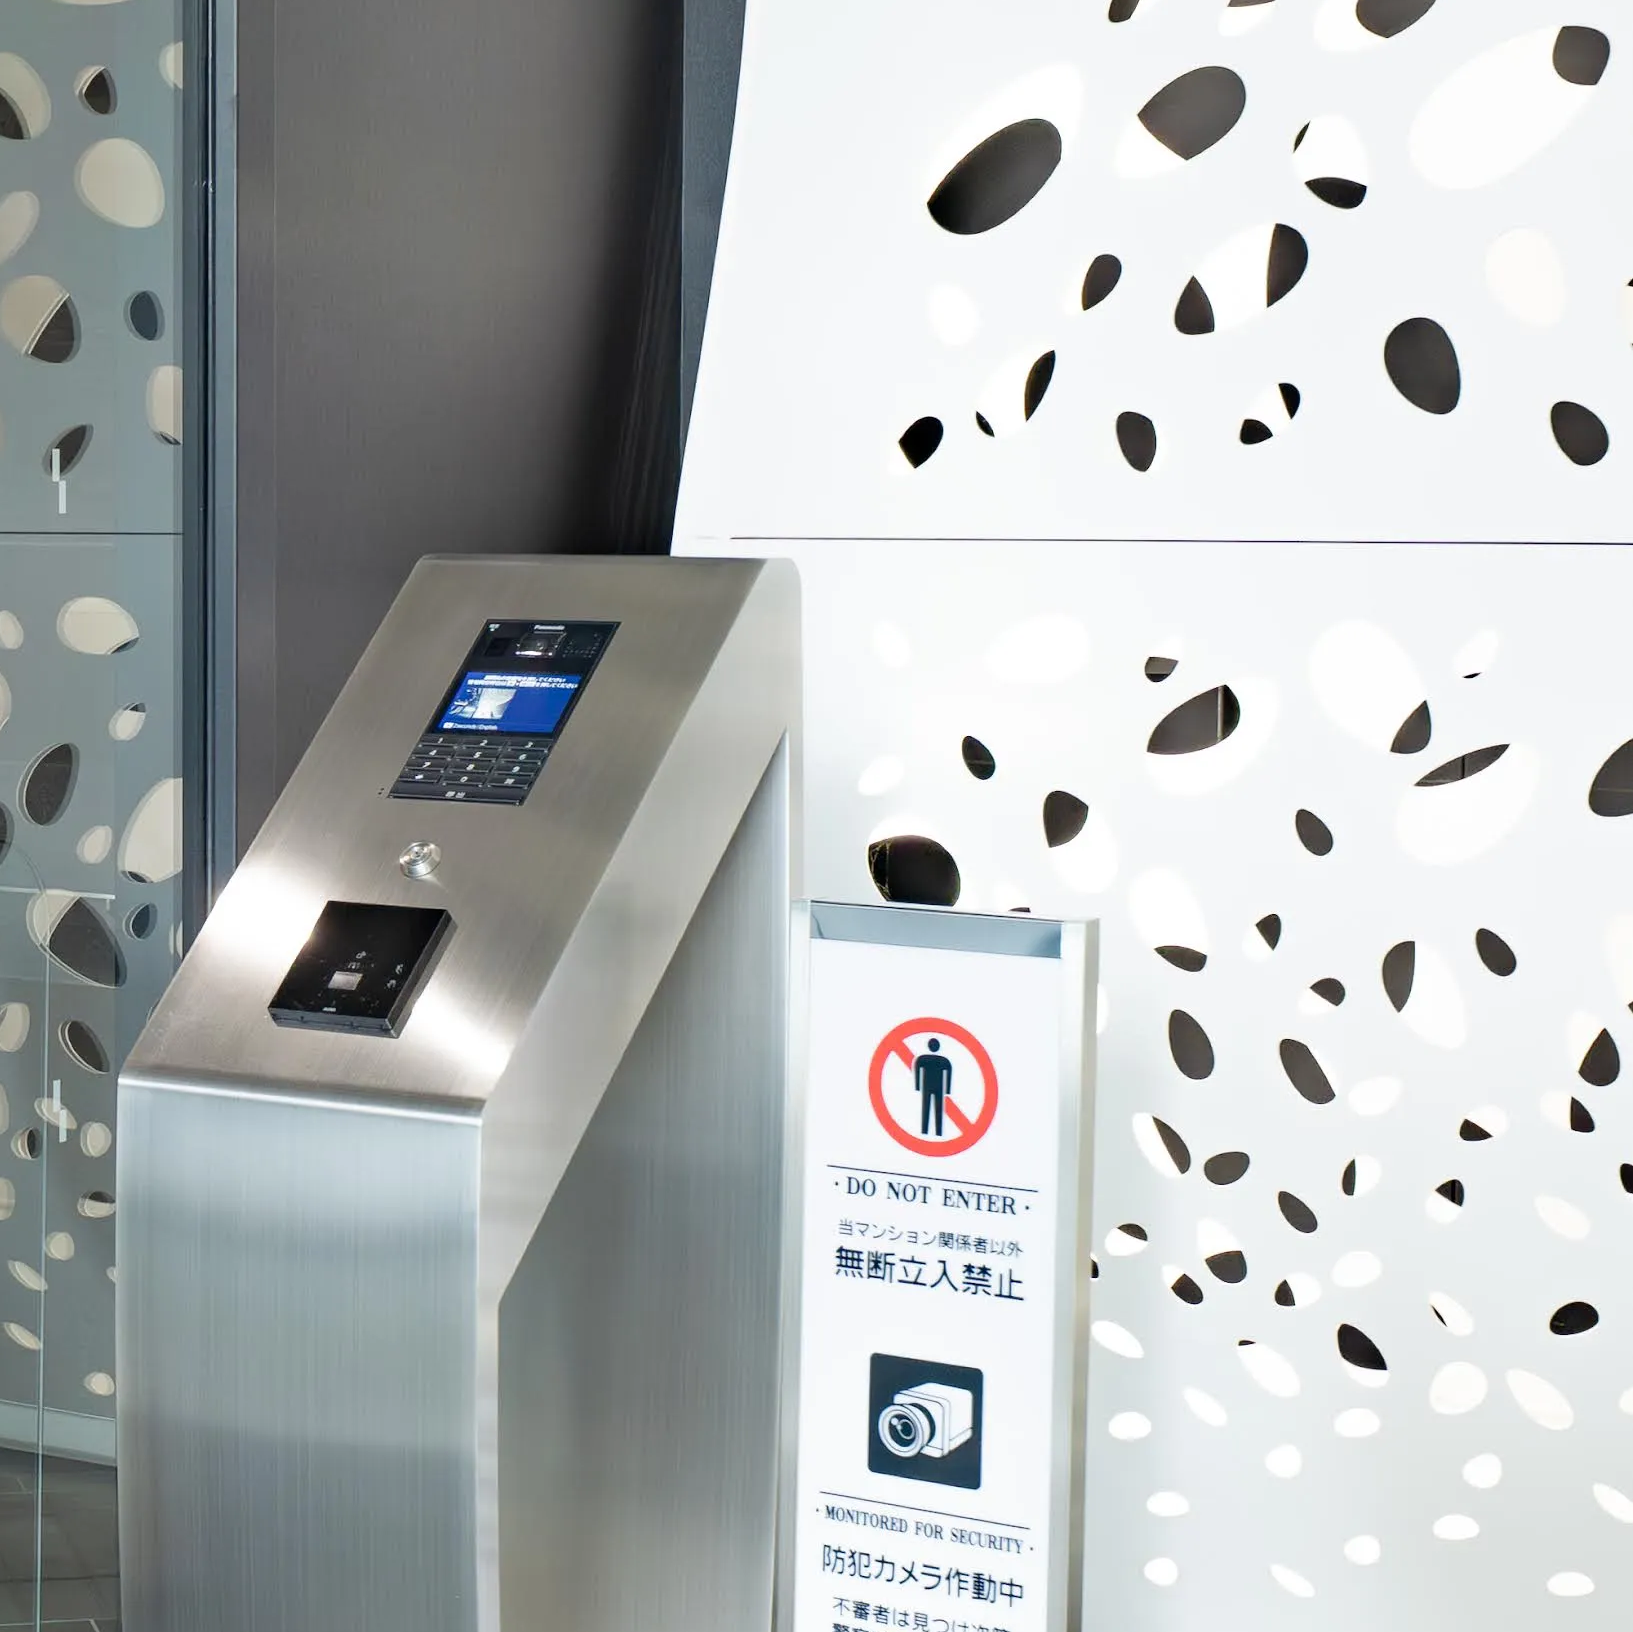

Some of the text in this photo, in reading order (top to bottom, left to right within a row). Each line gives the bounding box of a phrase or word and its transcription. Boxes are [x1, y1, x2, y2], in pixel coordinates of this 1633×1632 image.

[846, 1176, 1017, 1215] DO NOT ENTER
[838, 1219, 1024, 1258] 当マンション関係者以外
[836, 1245, 1024, 1301] 無断立入禁止
[825, 1505, 1024, 1554] MONITORED FOR SECURITY
[822, 1544, 1024, 1608] 防犯カメラ作動中
